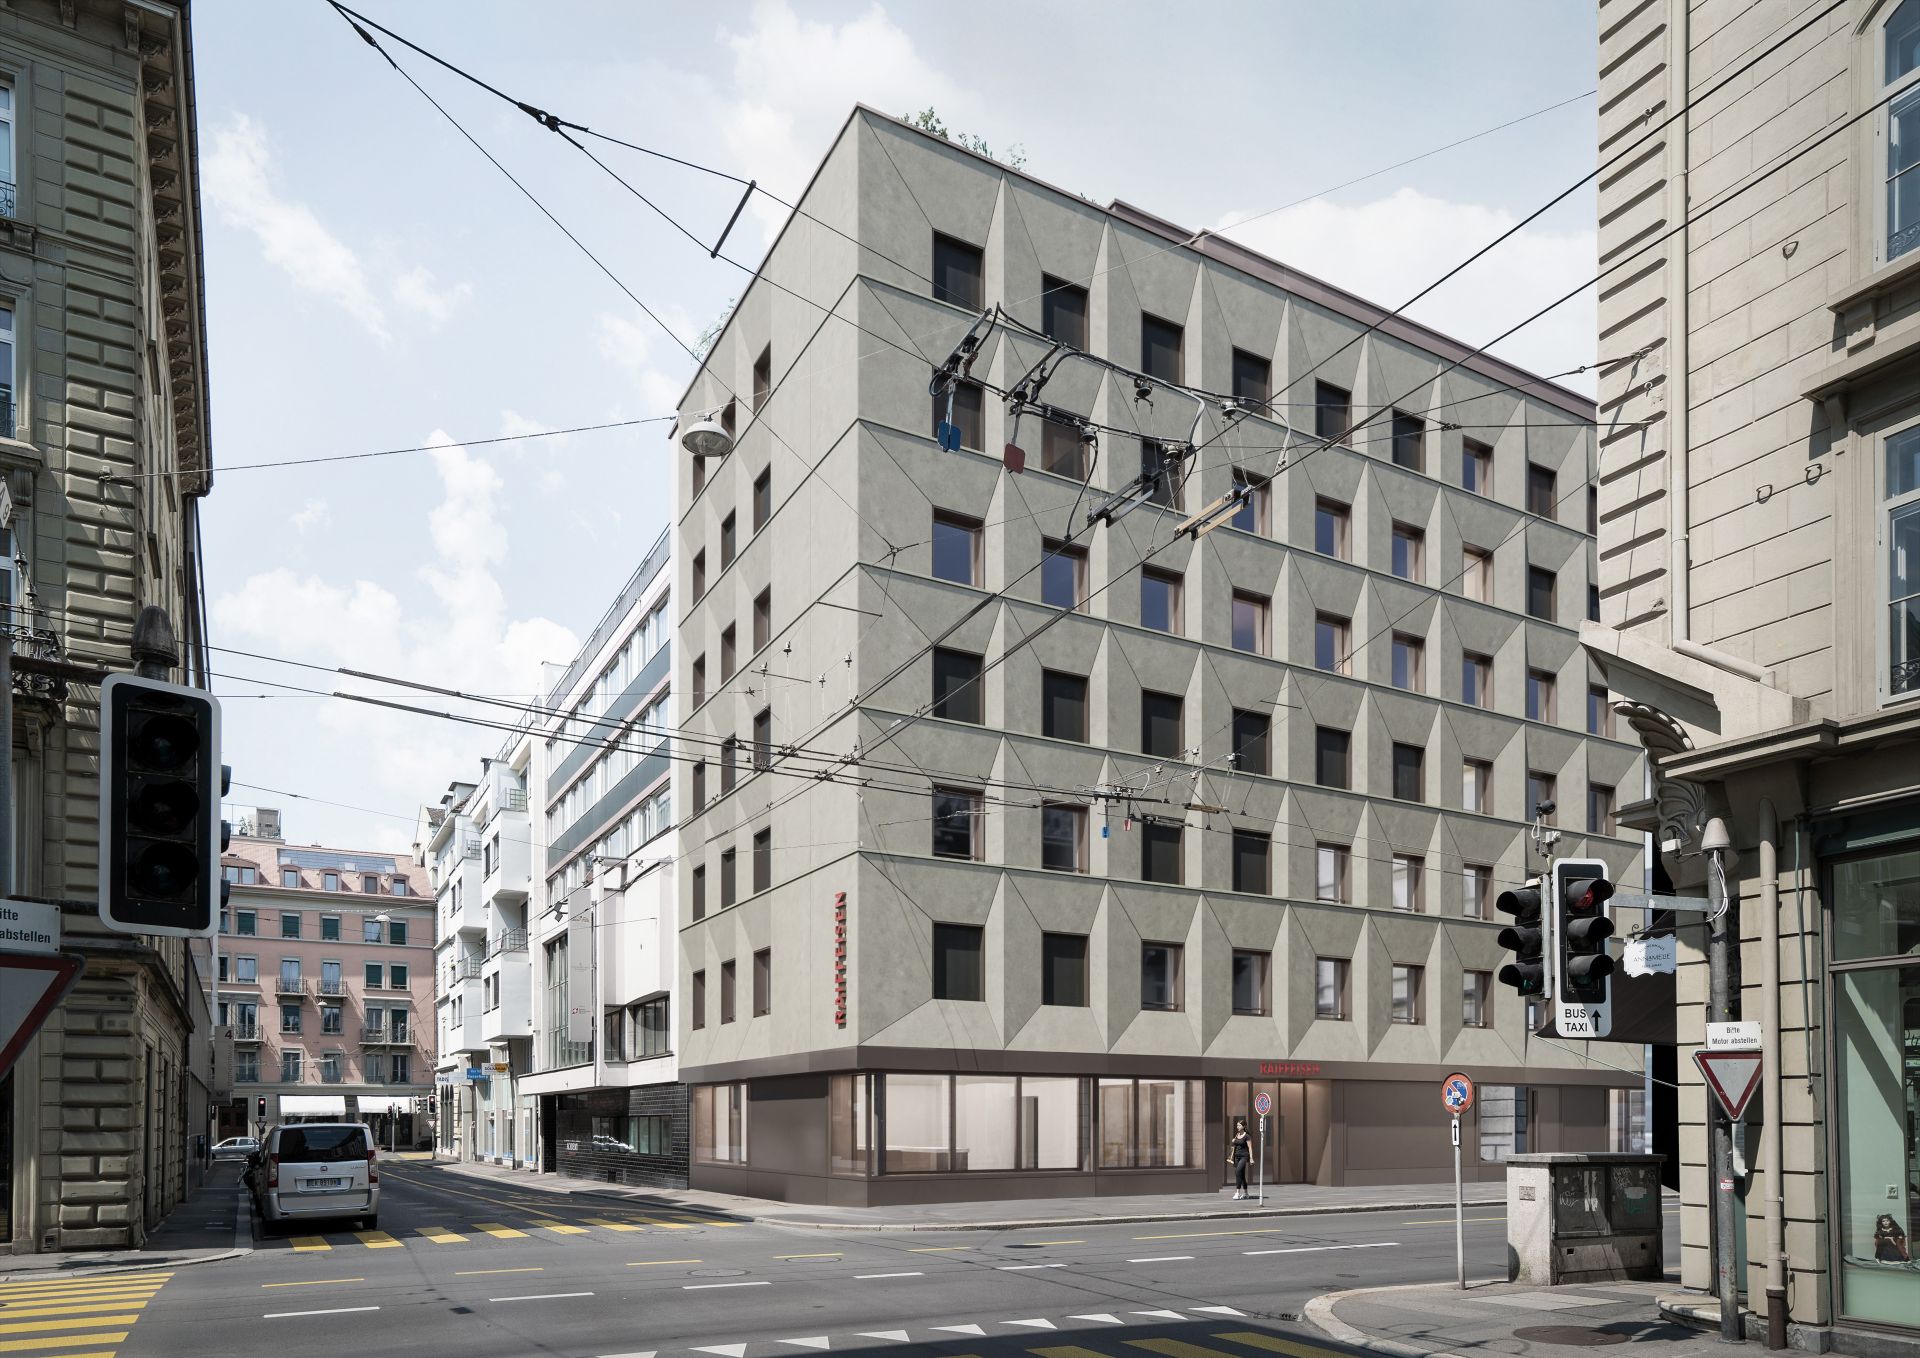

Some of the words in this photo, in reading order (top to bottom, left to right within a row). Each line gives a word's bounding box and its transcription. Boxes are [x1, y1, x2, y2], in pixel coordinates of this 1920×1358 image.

[0, 908, 19, 921] itte
[0, 928, 51, 944] abstellen
[834, 891, 847, 1029] RAIFFEISEN
[1564, 1008, 1587, 1019] BUS
[1564, 1022, 1588, 1032] TAXI
[1726, 1026, 1741, 1034] Bitte
[224, 1029, 233, 1040] 4
[1711, 1037, 1729, 1045] Motor
[1730, 1036, 1758, 1044] abstellen
[1260, 1062, 1320, 1074] RAIFFEISEN
